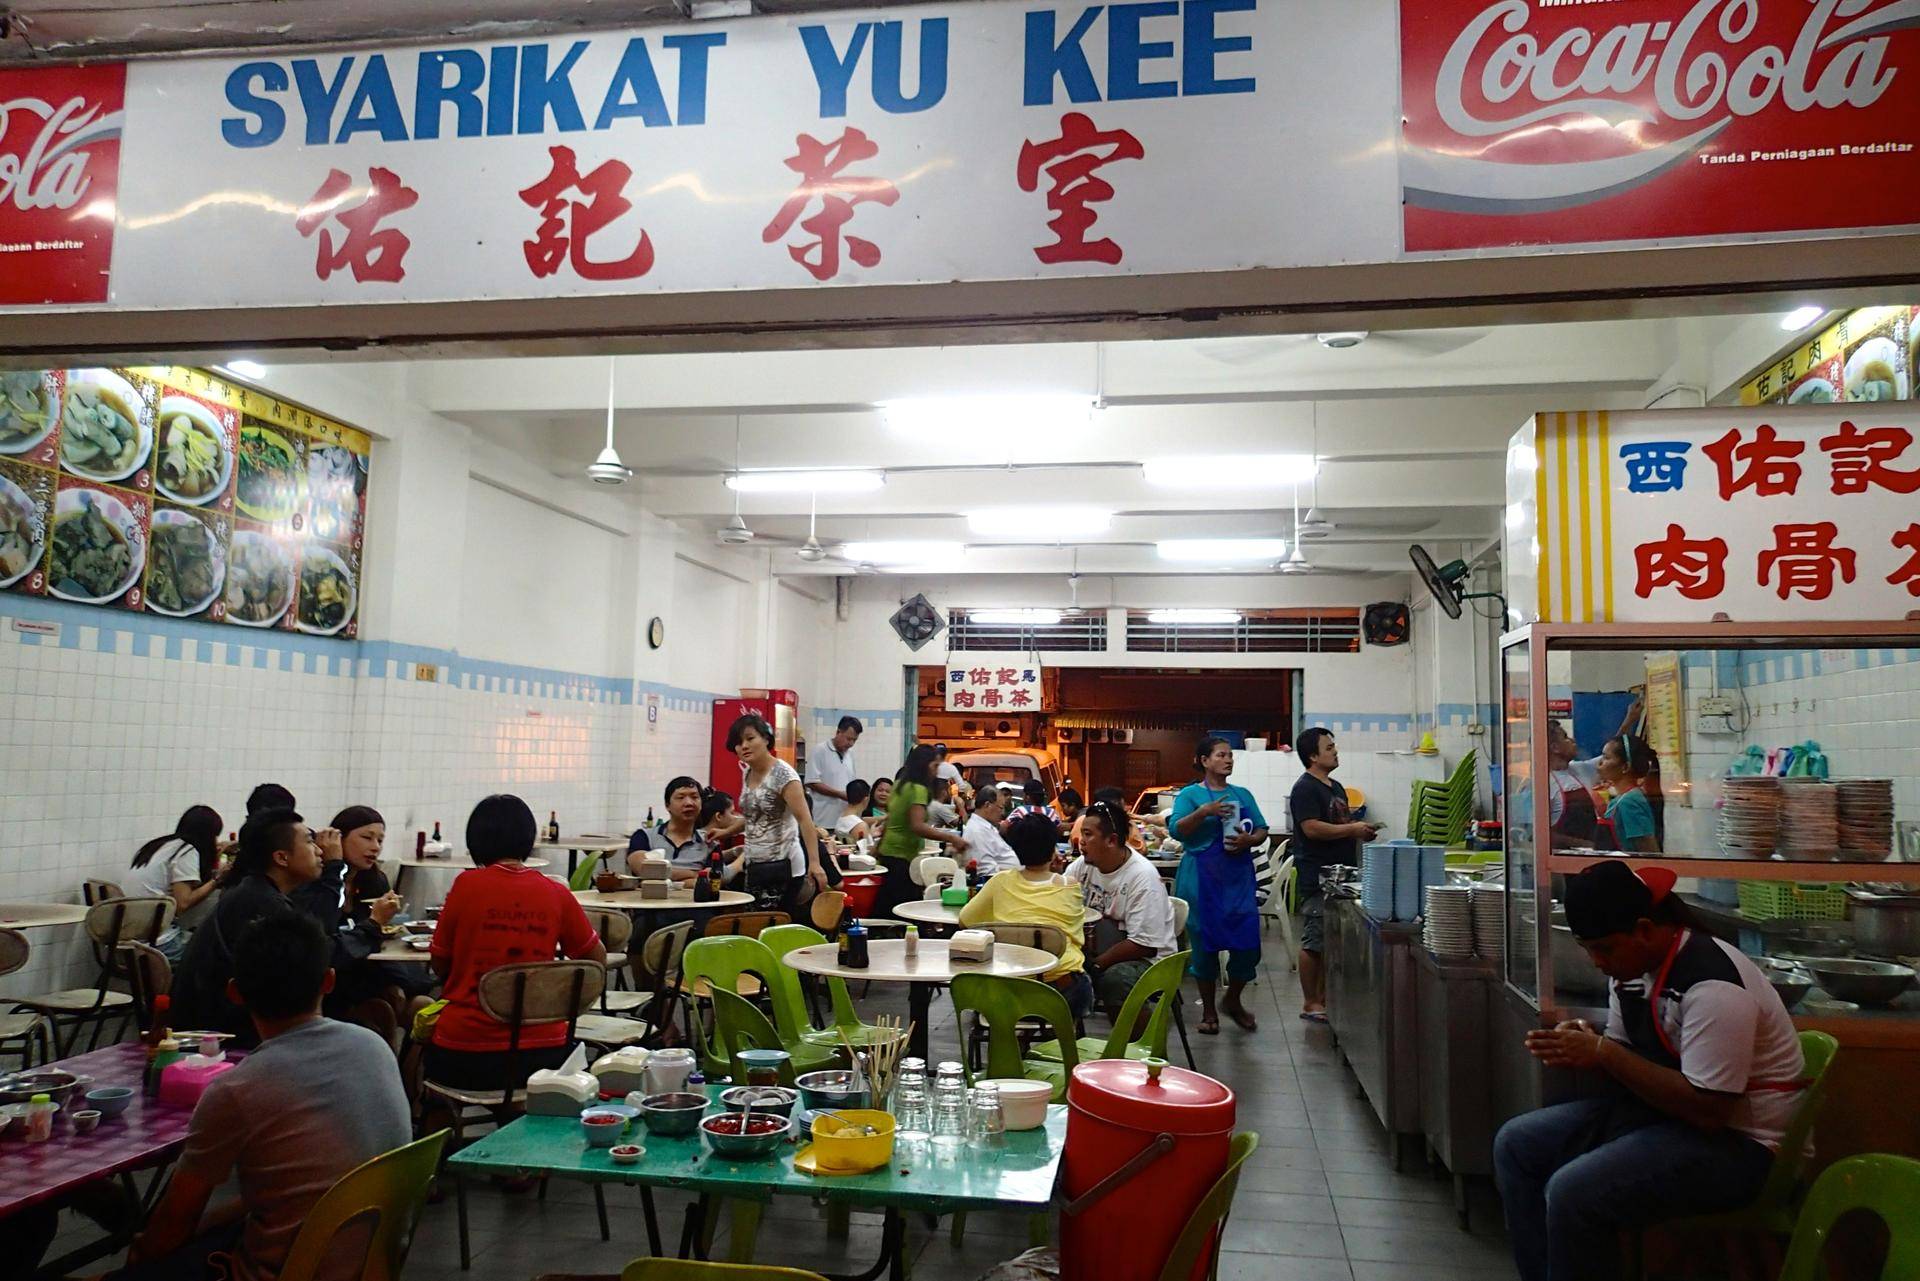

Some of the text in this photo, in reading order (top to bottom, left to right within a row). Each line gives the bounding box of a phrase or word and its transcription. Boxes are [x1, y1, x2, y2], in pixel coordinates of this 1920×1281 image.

[221, 0, 1257, 149] SYARIKAT YU KEE
[1435, 0, 1898, 137] Coca-Cola
[1700, 142, 1914, 165] Tanda Perniagaan Berdaftar
[34, 239, 85, 251] Berdaftar
[41, 447, 55, 462] 2
[139, 473, 150, 488] 3
[31, 572, 44, 590] 8
[130, 588, 141, 606] 9
[212, 601, 227, 617] 10
[953, 688, 1034, 708] 肉骨茶
